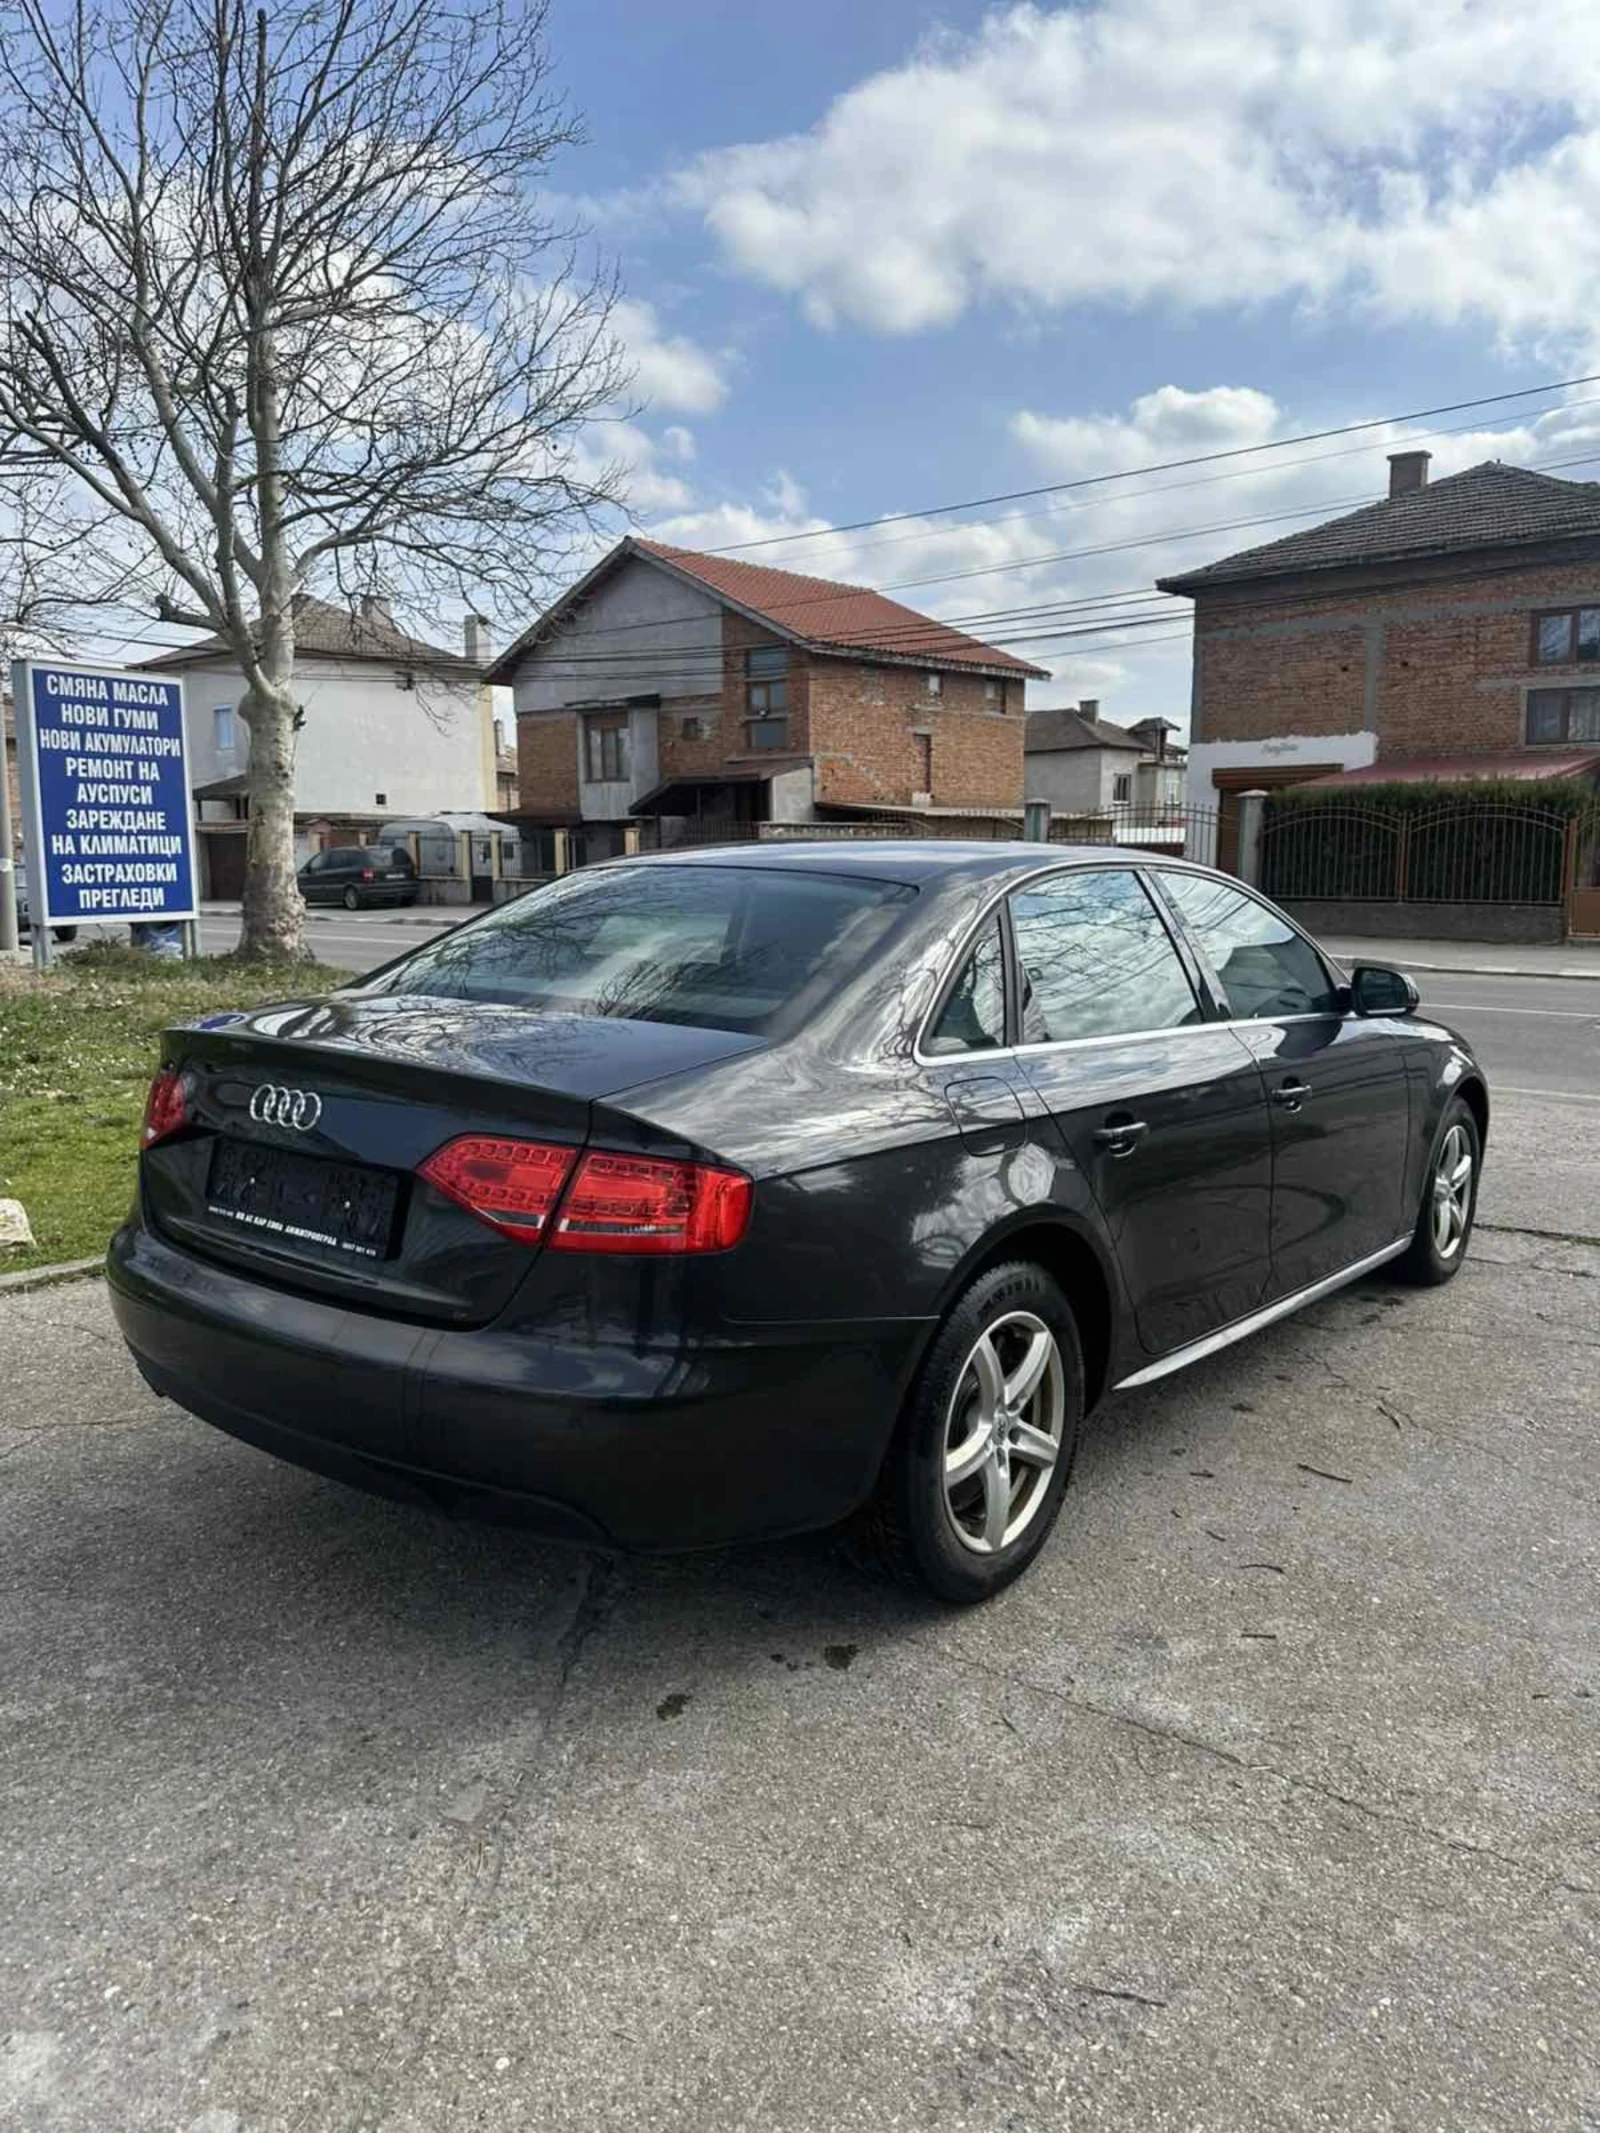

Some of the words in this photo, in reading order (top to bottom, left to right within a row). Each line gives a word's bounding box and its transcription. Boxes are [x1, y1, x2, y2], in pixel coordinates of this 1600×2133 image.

[47, 674, 109, 700] СМЯНА
[113, 681, 169, 706] МАСЛА
[61, 703, 108, 727] НОВИ
[114, 709, 159, 730] ГУМИ
[40, 728, 81, 751] НОВИ
[85, 731, 181, 757] АКУМУЛАТОРИ
[66, 757, 134, 780] РЕМОНТ
[139, 761, 160, 781] НА
[77, 783, 153, 805] АУСПУСИ
[66, 809, 166, 834] ЗАРЕЖДАНЕ
[52, 834, 76, 855] НА
[80, 834, 182, 858] КЛИМАТИЦИ
[62, 862, 178, 884] ЗАСТРАХОВКИ
[79, 887, 165, 910] ПРЕГЛЕДИ
